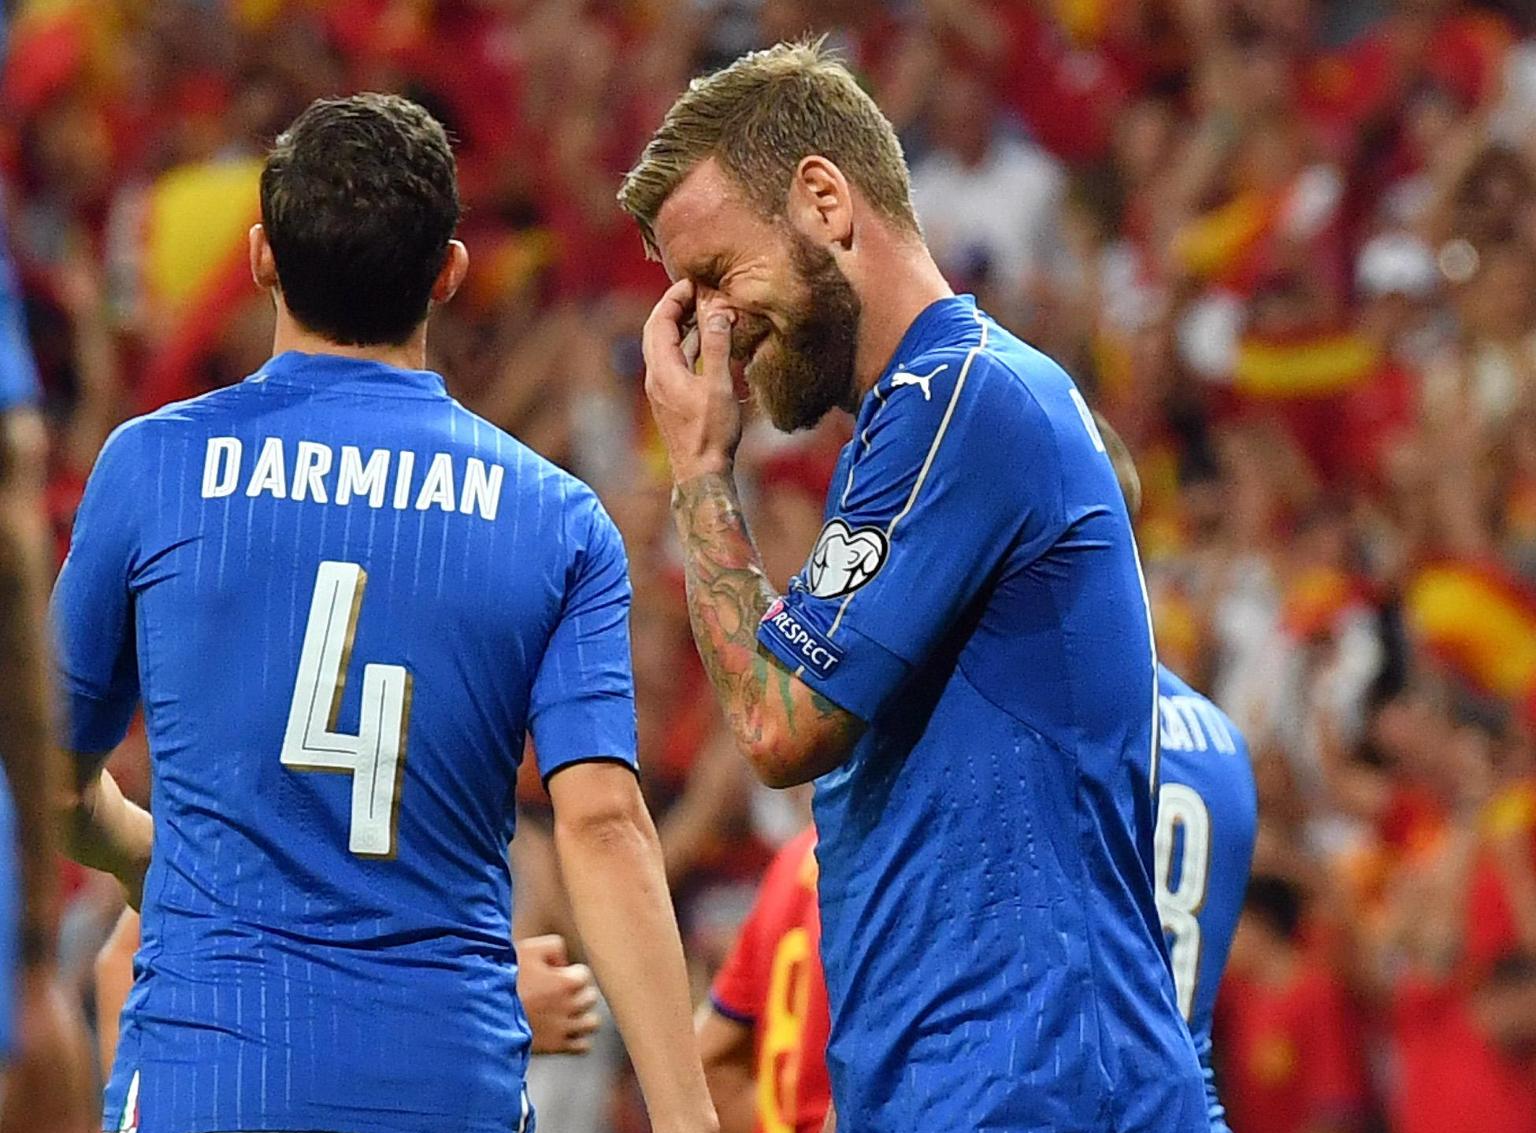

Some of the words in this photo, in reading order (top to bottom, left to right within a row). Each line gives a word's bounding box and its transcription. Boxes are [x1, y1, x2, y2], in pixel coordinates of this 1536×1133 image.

[201, 436, 504, 521] DARMIAN
[772, 611, 839, 671] RESPECT
[279, 561, 411, 859] 4
